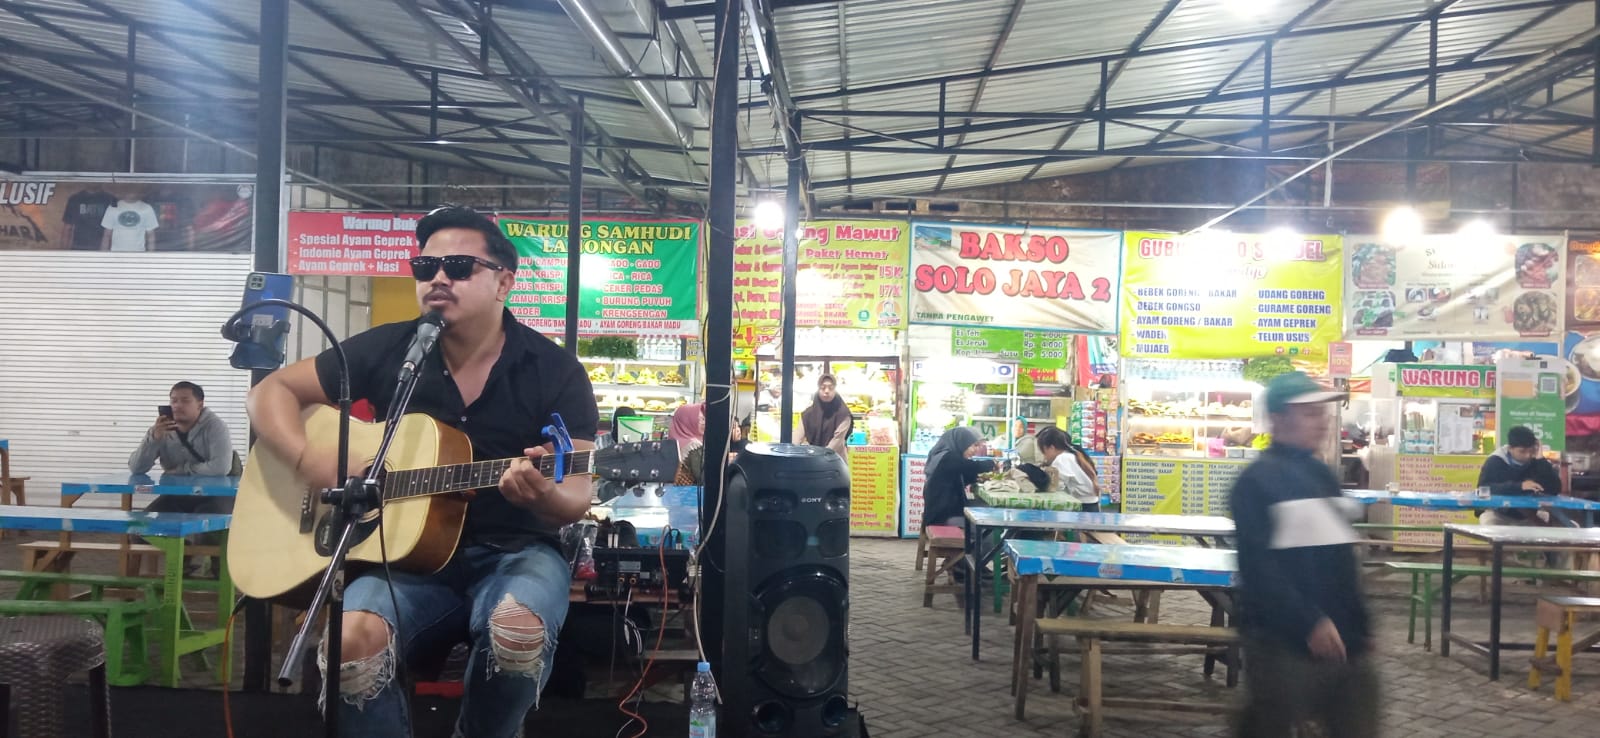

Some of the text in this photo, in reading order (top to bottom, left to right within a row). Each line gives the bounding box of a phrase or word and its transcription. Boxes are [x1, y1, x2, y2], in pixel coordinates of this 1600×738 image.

[343, 216, 419, 232] Warung Buk
[597, 224, 691, 240] SAMHUDI
[836, 225, 901, 242] Mawut
[300, 234, 412, 248] Spesial Ayam Geprek
[543, 240, 654, 254] LAONGAN
[959, 232, 1069, 264] BAKSO
[299, 247, 410, 261] Indomie Ayam Geprek
[806, 248, 888, 260] Paket Hemat
[298, 260, 324, 272] Ayam
[327, 260, 366, 273] Geprek
[376, 262, 399, 272] Nasi
[636, 260, 660, 269] GADO
[632, 273, 652, 281] RICA
[914, 264, 1110, 303] SOLO JAYA 2
[634, 285, 662, 294] PEDAS
[510, 294, 540, 303] JAMUR
[1258, 290, 1324, 300] UDANG GORENG
[602, 297, 672, 306] BURUNG PUYUH
[1137, 302, 1200, 312] BEBEK GONGSO
[1258, 304, 1332, 314] GURAME GORENG
[602, 310, 667, 318] KRENGSENGAN
[916, 311, 944, 320] TANPA
[1136, 316, 1160, 326] AYAM
[1161, 316, 1196, 326] GORENG
[1204, 317, 1232, 327] BAKAR
[1258, 318, 1316, 328] AYAM GEPREK
[1258, 332, 1310, 342] TELUR USUS
[1136, 344, 1169, 354] MUJAER
[1402, 368, 1480, 388] WARUNG
